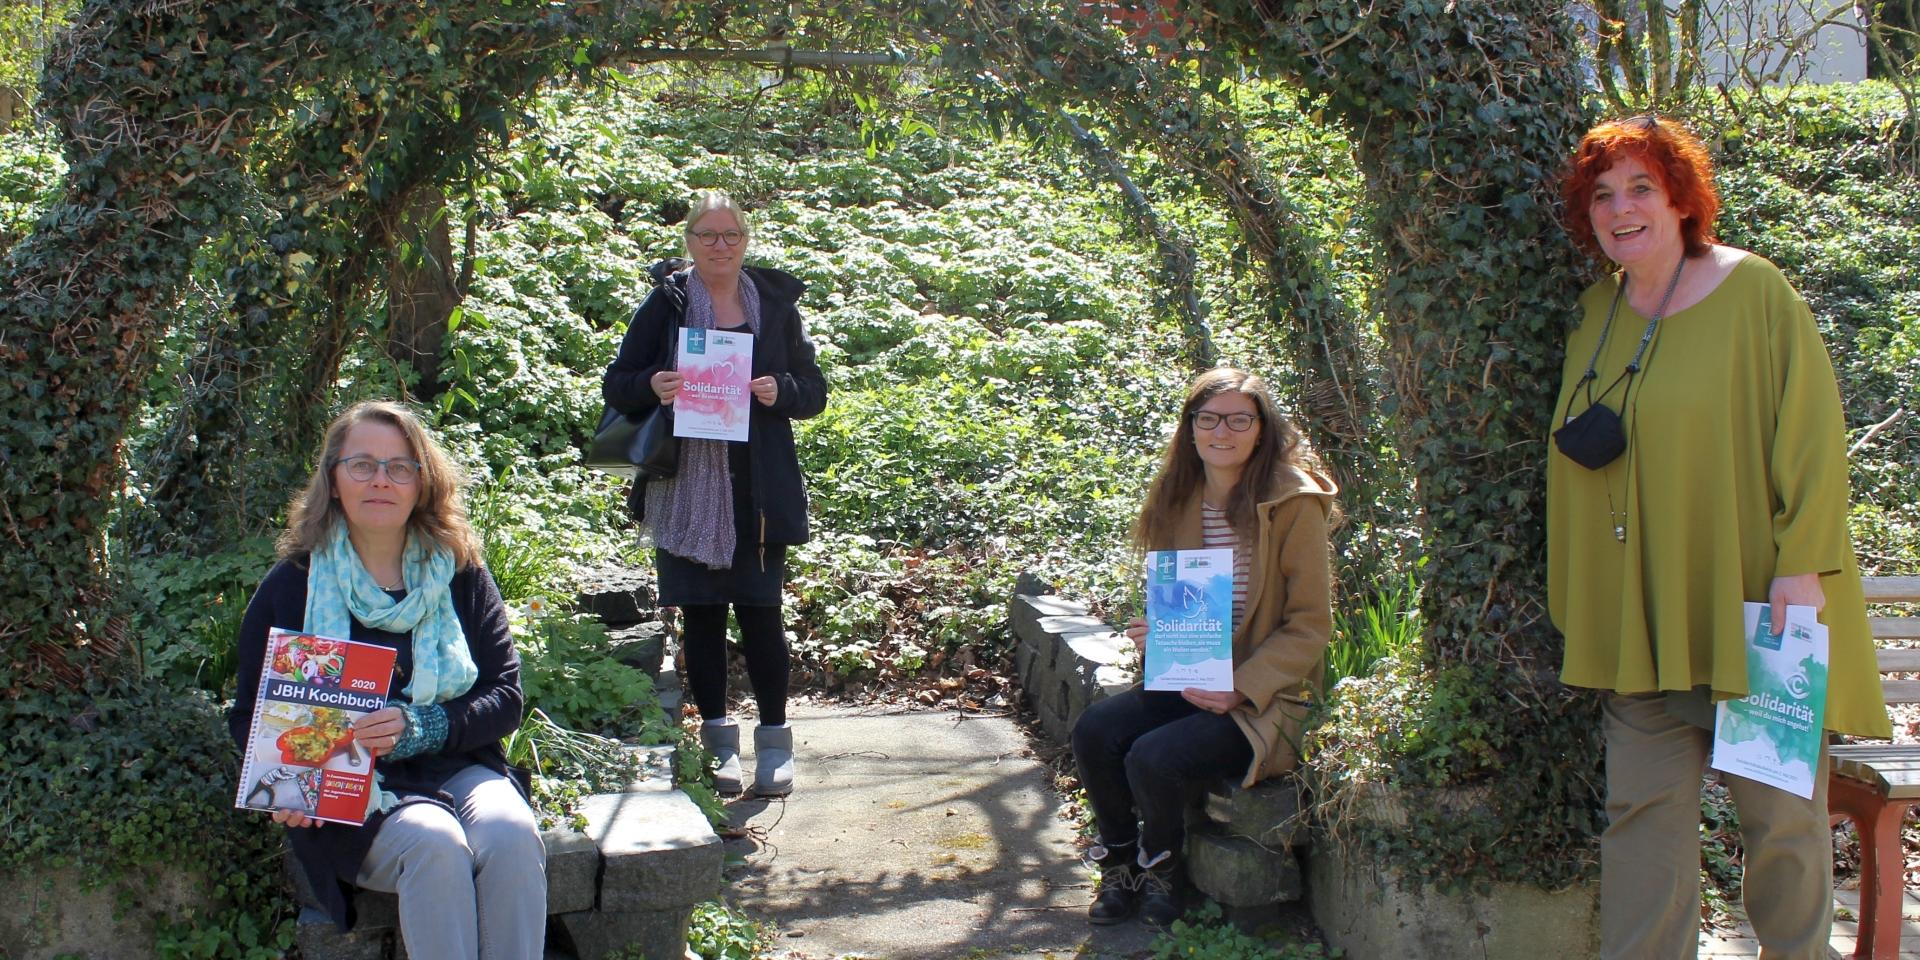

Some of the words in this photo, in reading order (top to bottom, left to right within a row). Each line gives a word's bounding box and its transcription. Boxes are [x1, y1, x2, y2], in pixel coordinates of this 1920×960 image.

[683, 381, 742, 395] Solidarität
[1156, 619, 1222, 632] Solidarität
[351, 679, 376, 690] 2020
[272, 683, 306, 699] JBH
[308, 687, 384, 709] Kochbuch
[1739, 692, 1814, 723] olidarität
[1749, 709, 1763, 717] weil
[1763, 712, 1772, 720] du
[1772, 716, 1787, 724] mich
